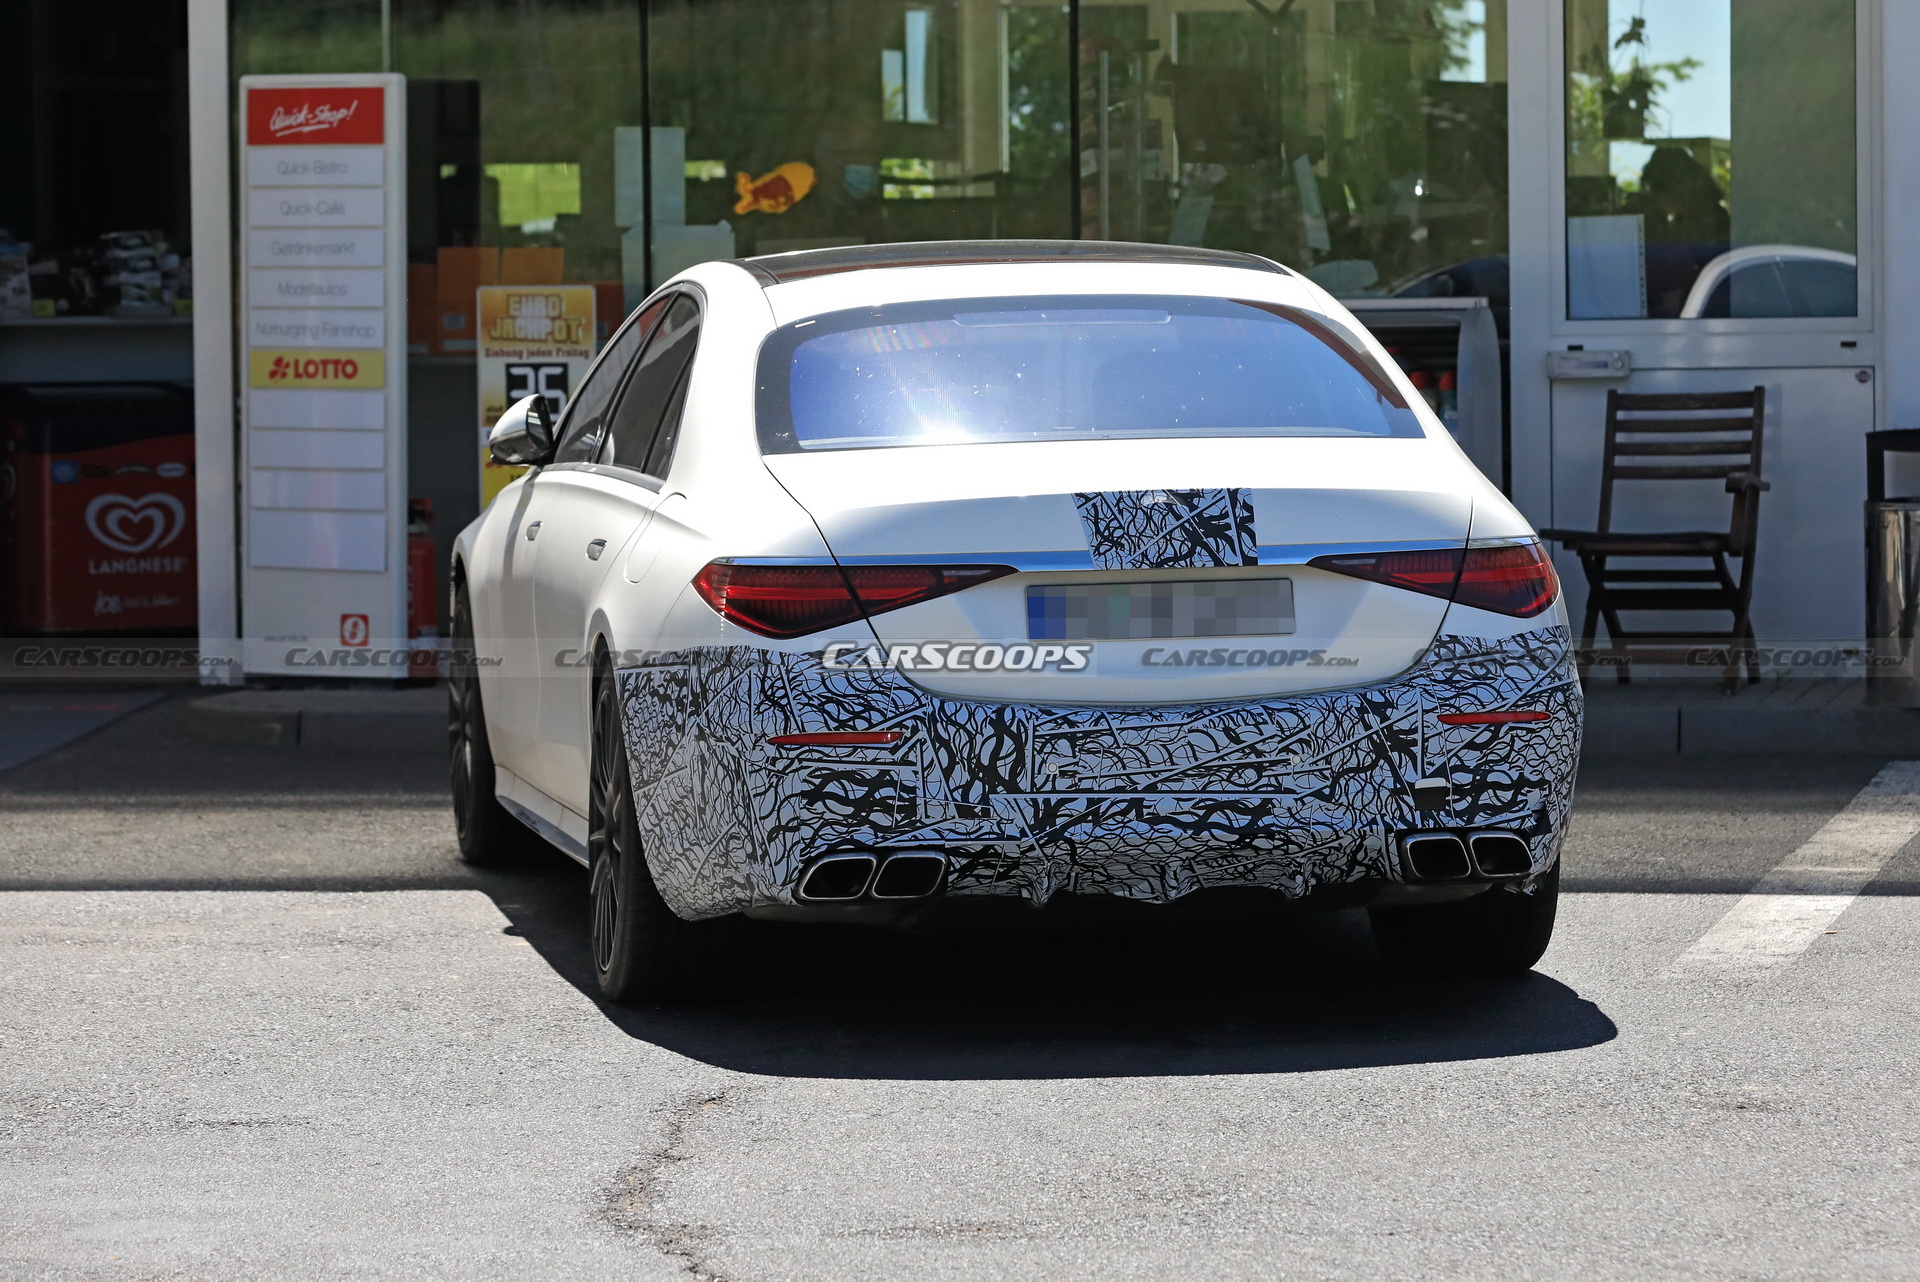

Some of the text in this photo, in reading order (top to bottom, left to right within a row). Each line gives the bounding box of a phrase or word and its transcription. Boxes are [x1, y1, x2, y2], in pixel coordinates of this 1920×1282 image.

[269, 100, 359, 132] Quick-Shop!
[276, 160, 348, 175] Quick-Bistro
[279, 201, 346, 216] Quick-Café
[507, 294, 561, 317] EURO
[321, 321, 377, 338] Fanshop
[490, 317, 581, 343] JACKPOT
[527, 347, 553, 359] jeden
[556, 346, 590, 360] Freitag
[293, 358, 359, 379] LOTTO
[88, 556, 183, 575] LANGNESE
